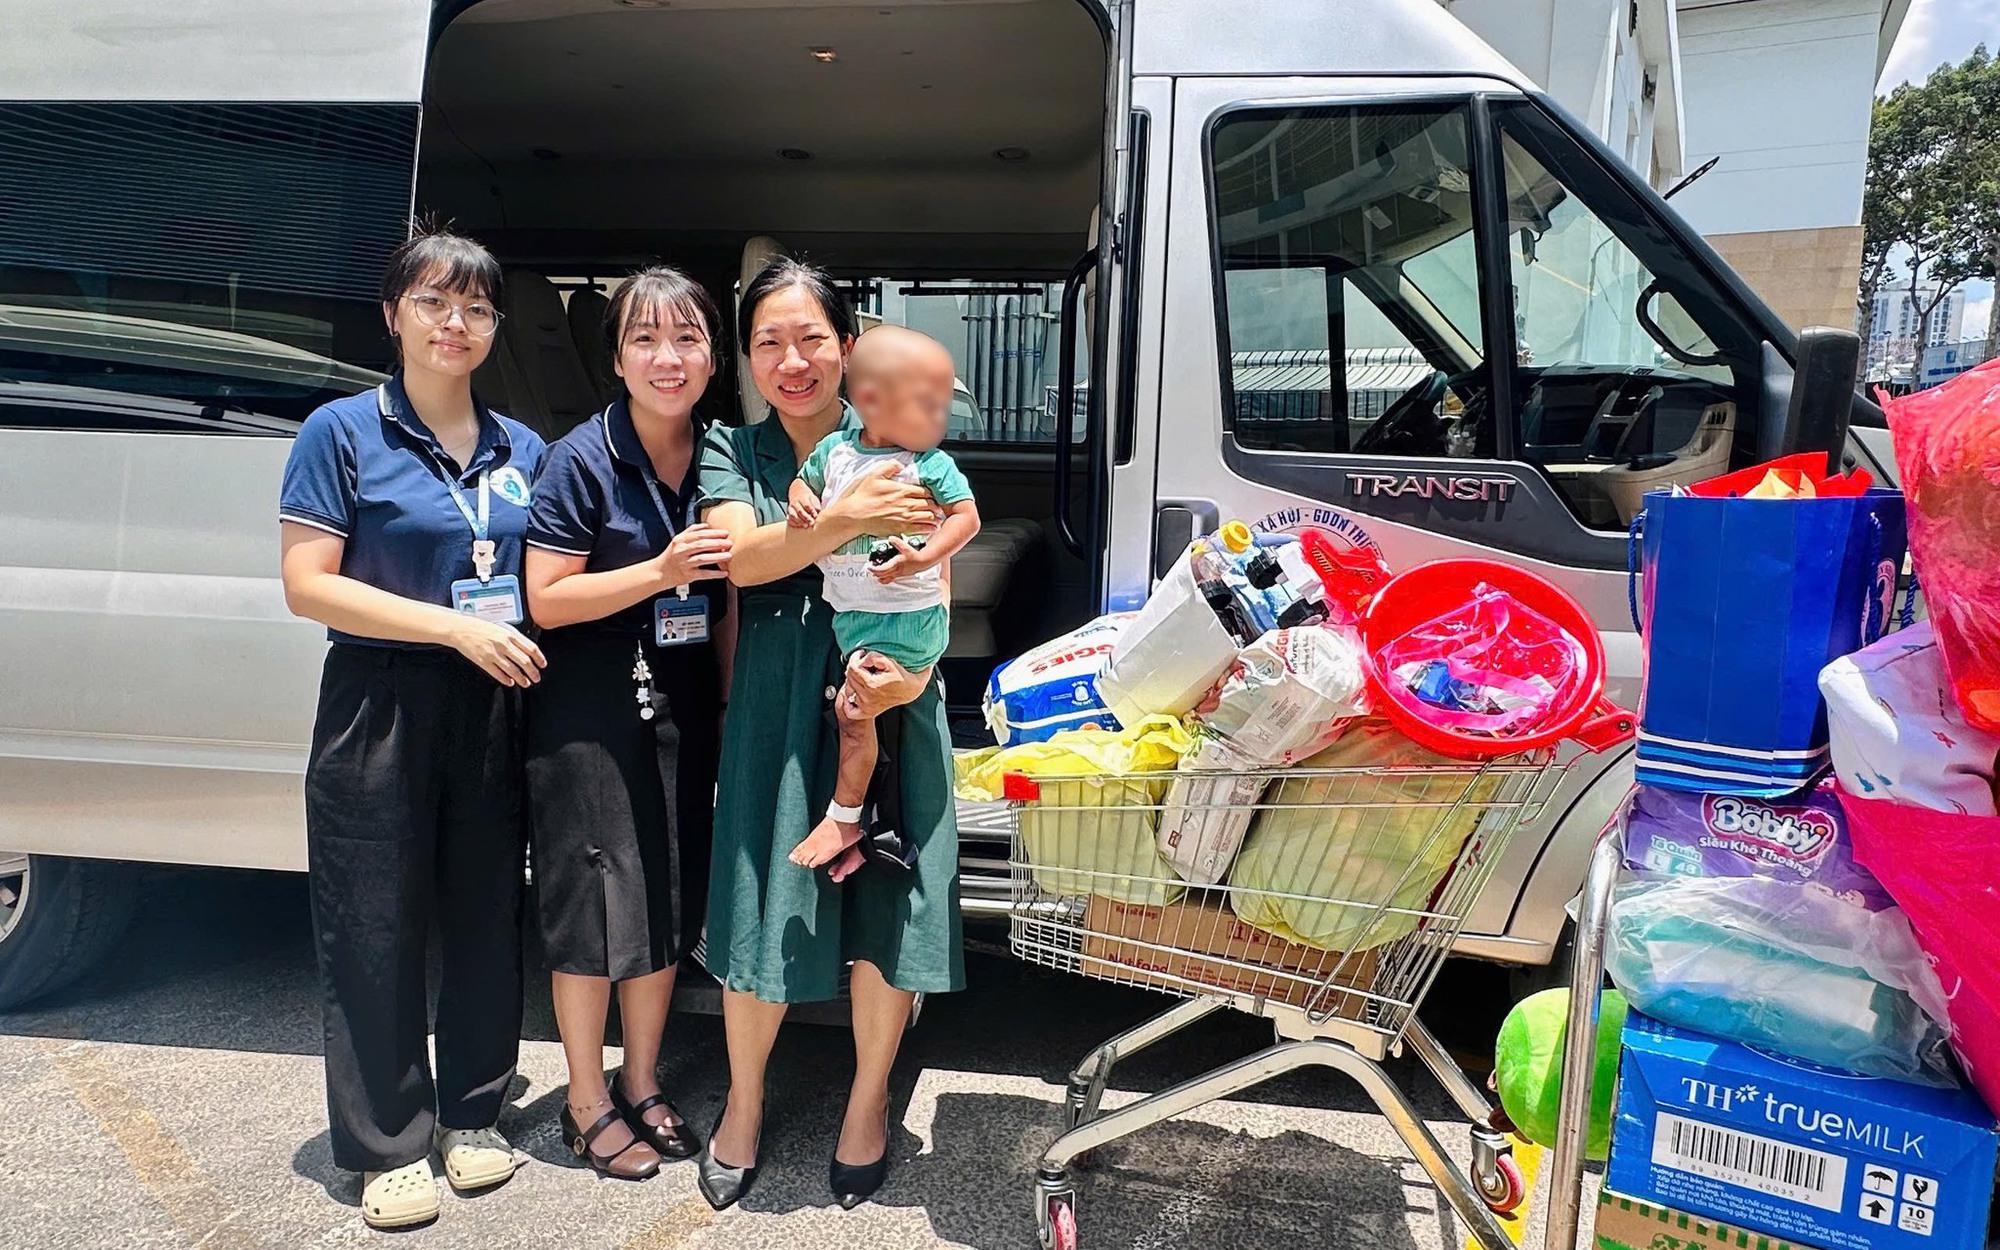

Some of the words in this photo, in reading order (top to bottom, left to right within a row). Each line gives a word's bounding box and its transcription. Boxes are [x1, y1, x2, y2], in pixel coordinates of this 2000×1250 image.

[1346, 474, 1516, 501] TRANSIT
[1713, 797, 1827, 855] Bobby
[1675, 861, 1695, 874] 48
[1681, 1077, 1733, 1112] TH
[1906, 1207, 1926, 1220] 10
